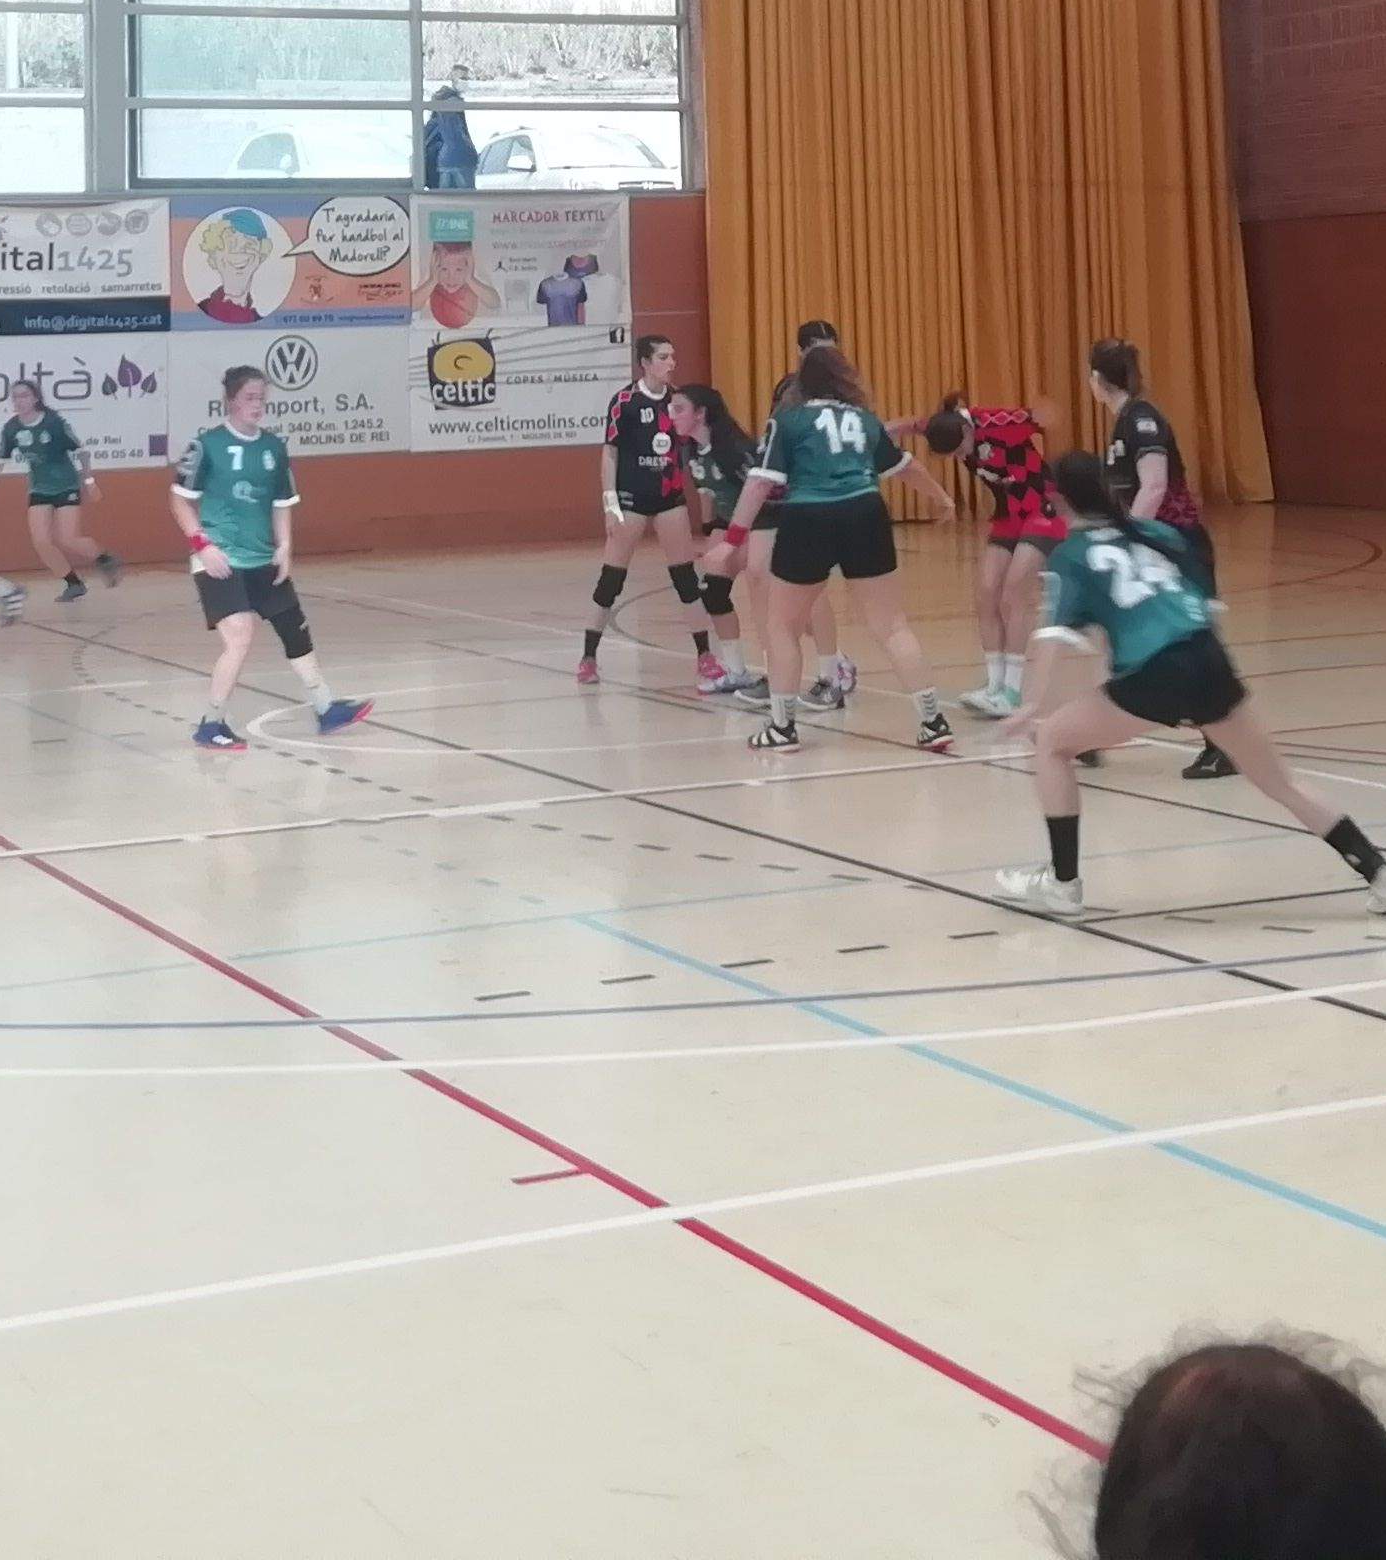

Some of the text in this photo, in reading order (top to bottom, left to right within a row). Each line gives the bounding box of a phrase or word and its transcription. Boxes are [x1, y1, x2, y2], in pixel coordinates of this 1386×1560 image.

[341, 228, 387, 242] handbol
[393, 227, 404, 241] al
[41, 282, 91, 294] retolació
[100, 281, 162, 293] samarretes
[432, 378, 495, 402] celtic
[335, 393, 374, 412] S.A.
[640, 407, 654, 423] 10
[288, 422, 312, 433] 340
[814, 407, 867, 454] 14
[299, 431, 390, 446] MOLINS DE REI
[227, 445, 243, 471] 7
